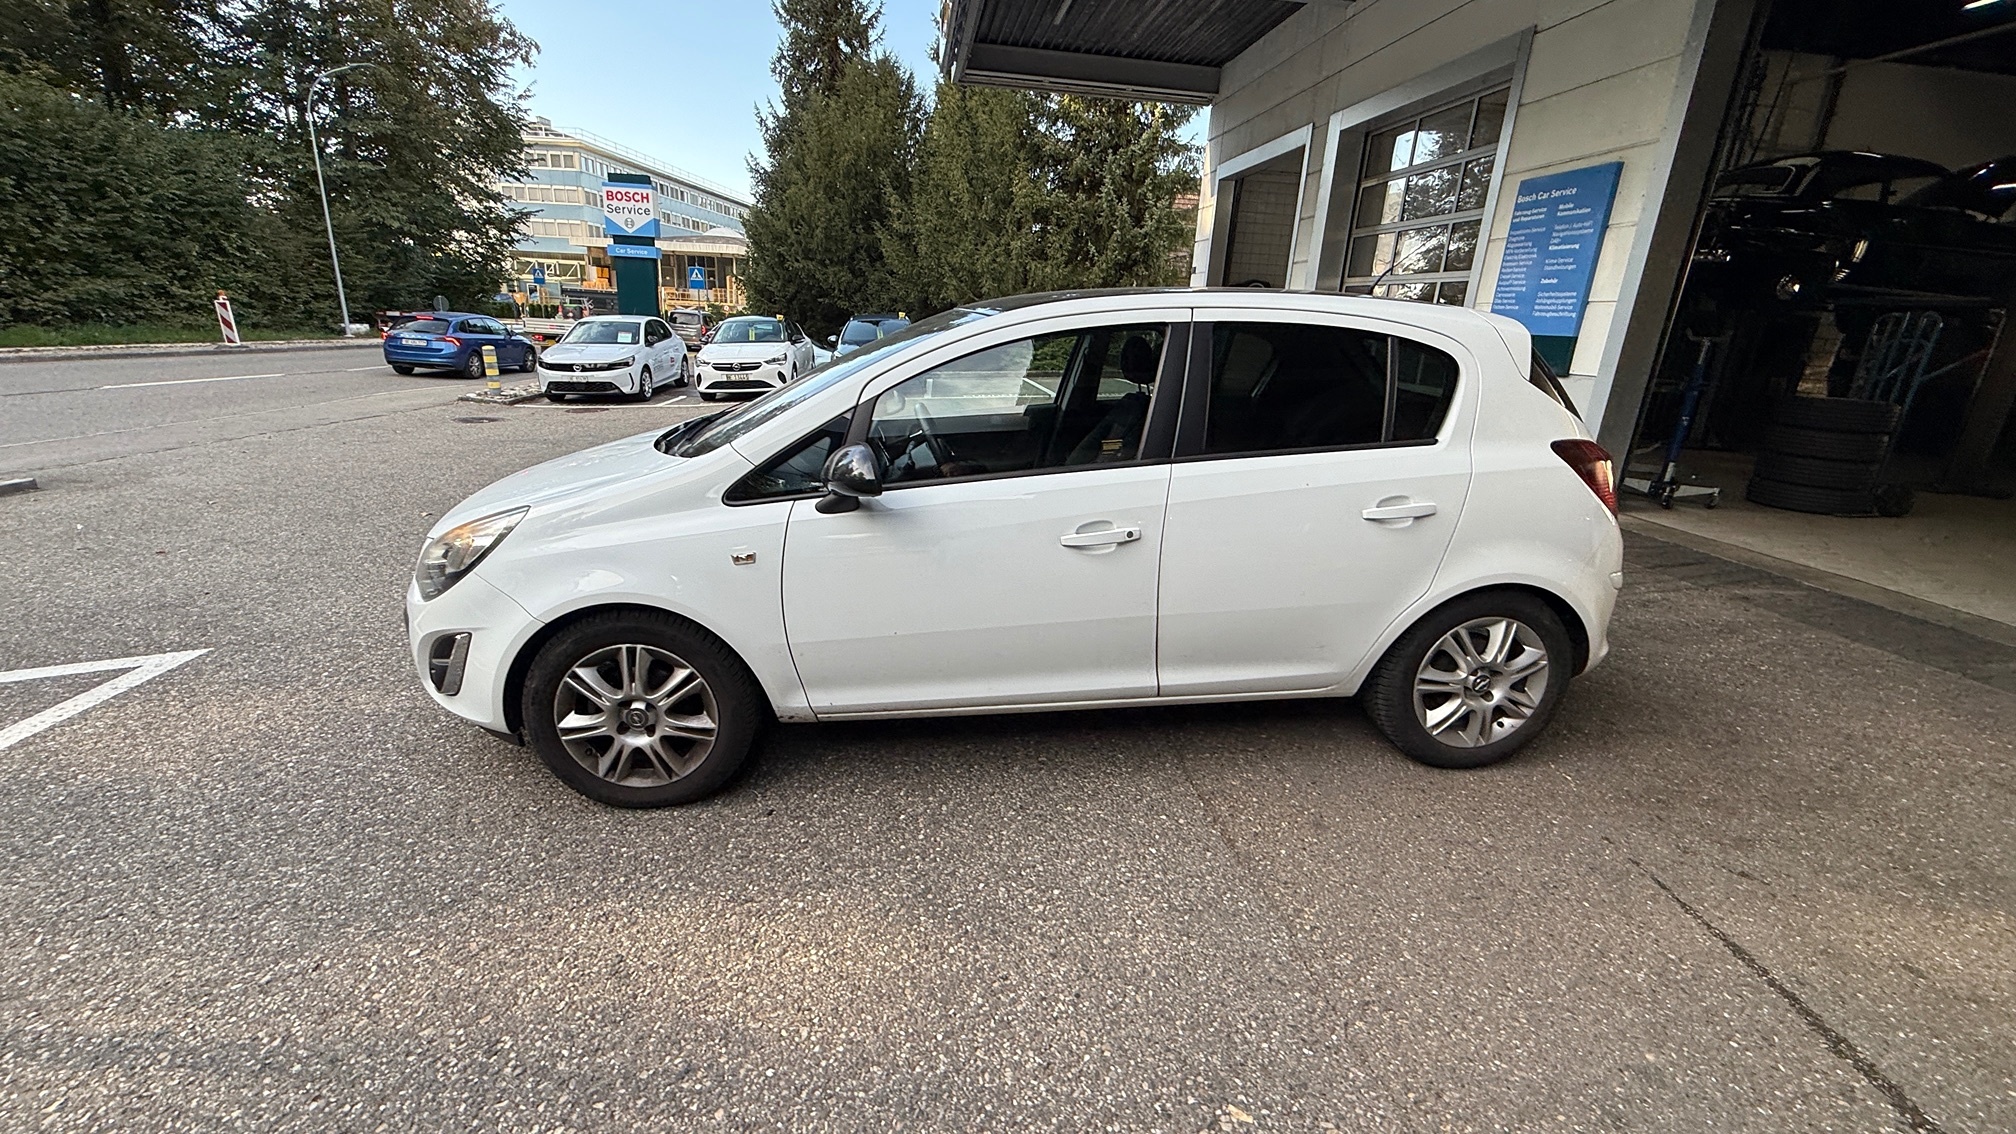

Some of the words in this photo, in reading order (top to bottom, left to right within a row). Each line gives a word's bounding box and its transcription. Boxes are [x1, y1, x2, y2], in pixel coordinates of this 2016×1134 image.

[606, 190, 650, 203] BOSCH
[1518, 194, 1536, 203] Bosch
[1538, 192, 1549, 200] Car
[1550, 187, 1577, 198] Service
[606, 204, 650, 216] Service
